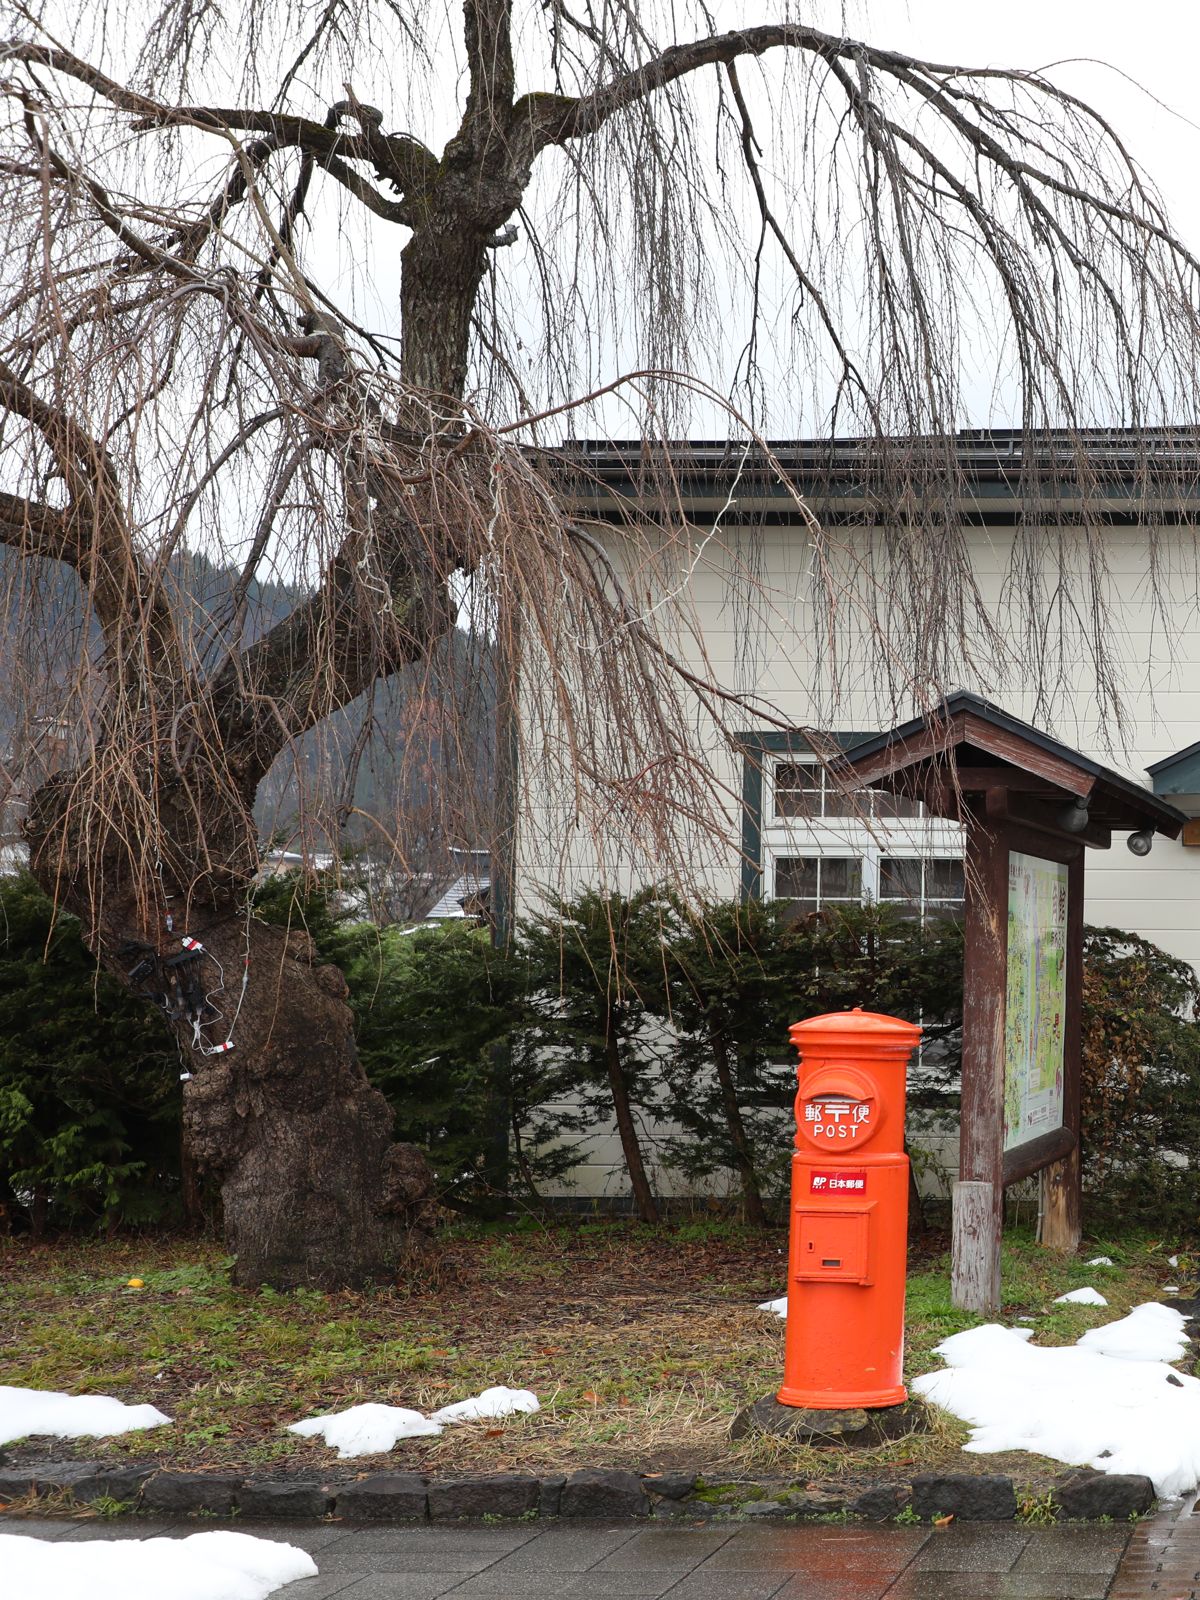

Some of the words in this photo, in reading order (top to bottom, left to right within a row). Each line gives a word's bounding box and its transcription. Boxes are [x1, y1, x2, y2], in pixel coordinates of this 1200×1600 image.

[814, 1124, 859, 1138] POST
[829, 1178, 864, 1189] 日本郵便
